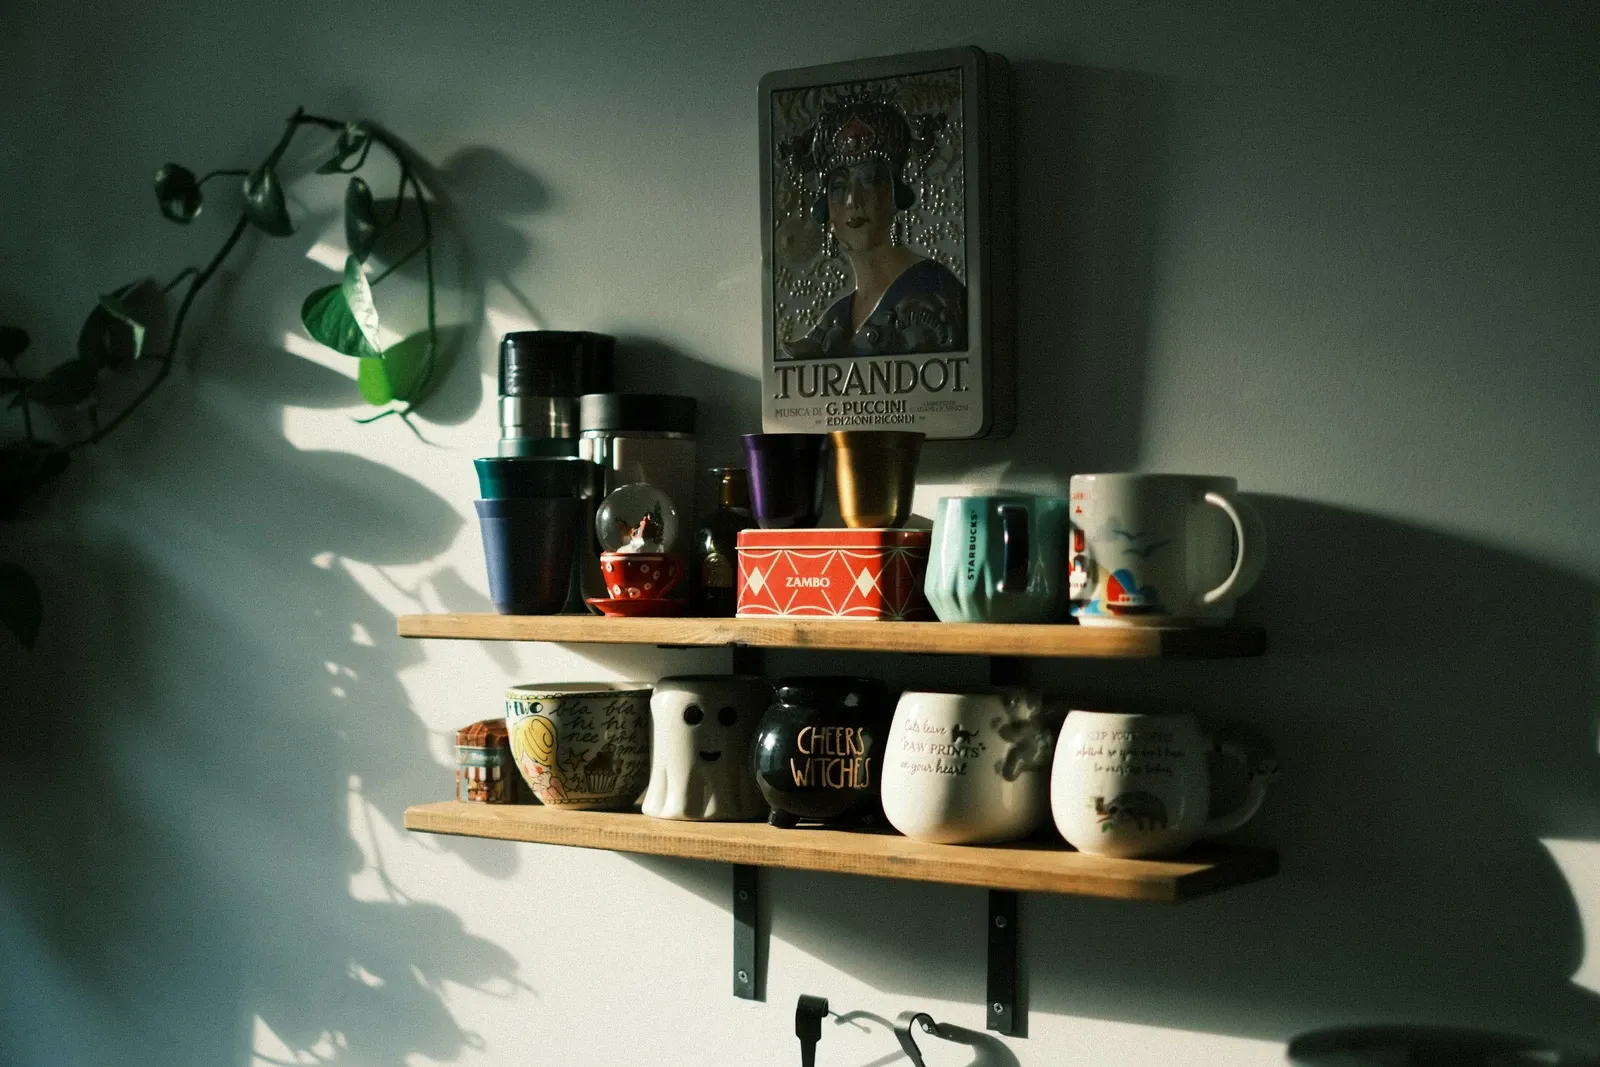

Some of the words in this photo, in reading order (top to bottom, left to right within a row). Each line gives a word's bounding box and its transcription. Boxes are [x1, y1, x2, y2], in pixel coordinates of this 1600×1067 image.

[826, 415, 874, 426] EDIZIONI
[875, 414, 914, 425] RICORDI
[967, 513, 978, 580] STARBUCKS
[785, 576, 830, 588] ZAMBO
[923, 720, 947, 734] leave
[797, 725, 865, 756] CHEERS
[790, 756, 872, 789] WITCHES
[935, 758, 967, 776] heart
